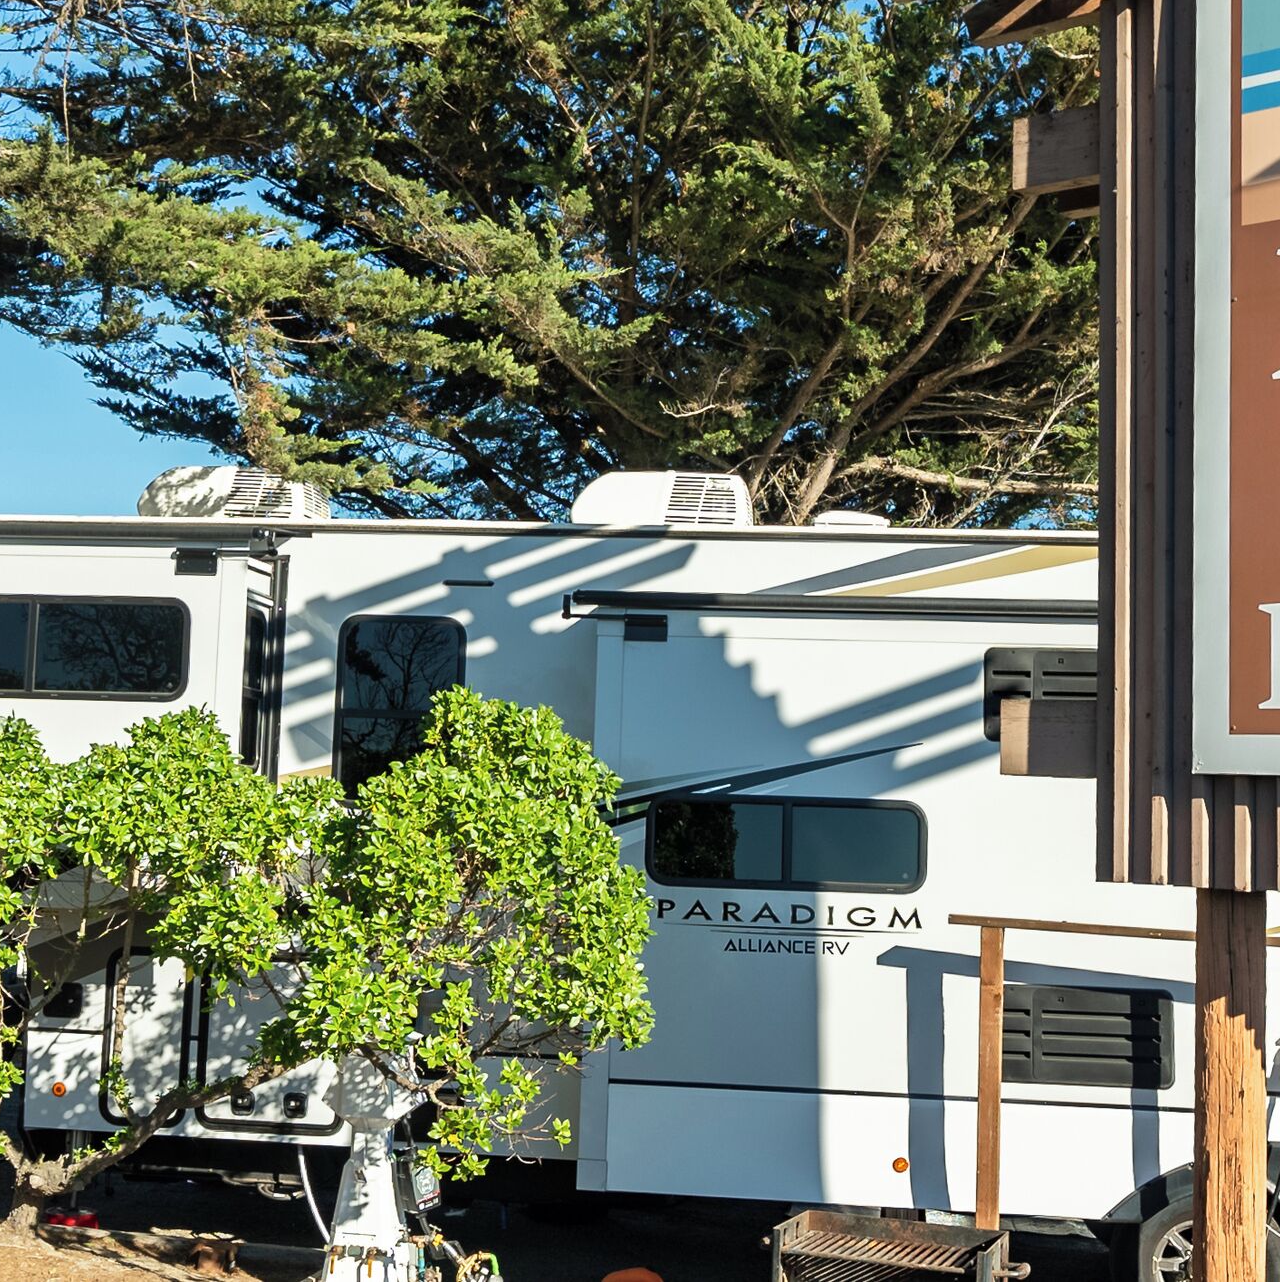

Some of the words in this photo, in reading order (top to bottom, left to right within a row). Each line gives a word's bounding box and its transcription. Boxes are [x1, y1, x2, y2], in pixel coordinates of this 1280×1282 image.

[656, 898, 923, 929] PARADIGM
[723, 938, 816, 955] ALLIANCE
[822, 940, 850, 956] RV
